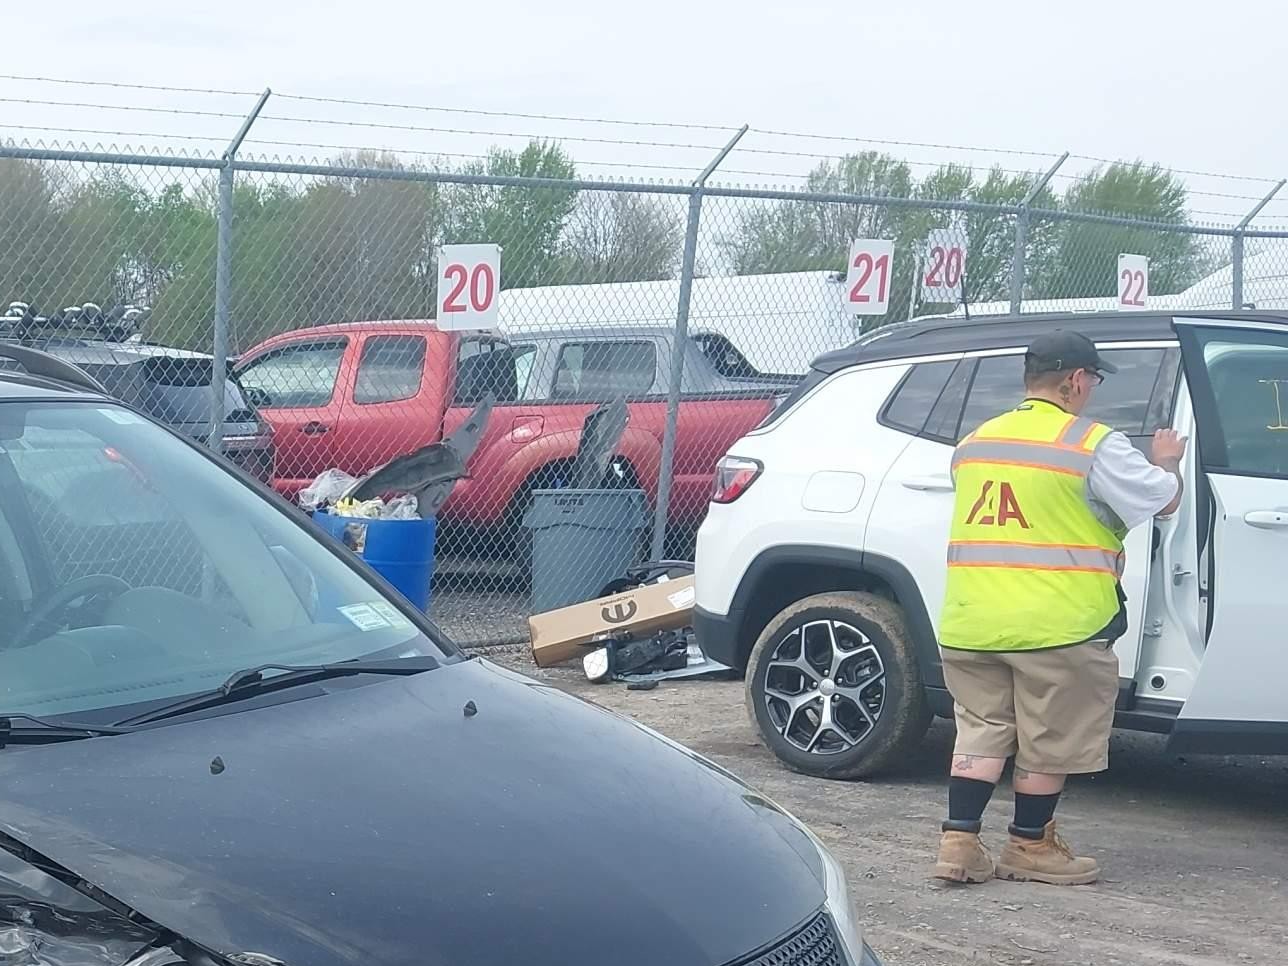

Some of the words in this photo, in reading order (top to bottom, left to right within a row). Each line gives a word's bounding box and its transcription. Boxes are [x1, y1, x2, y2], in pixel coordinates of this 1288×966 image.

[442, 263, 494, 313] 20
[850, 253, 889, 303] 21
[926, 246, 962, 288] 20
[1121, 269, 1145, 307] 22
